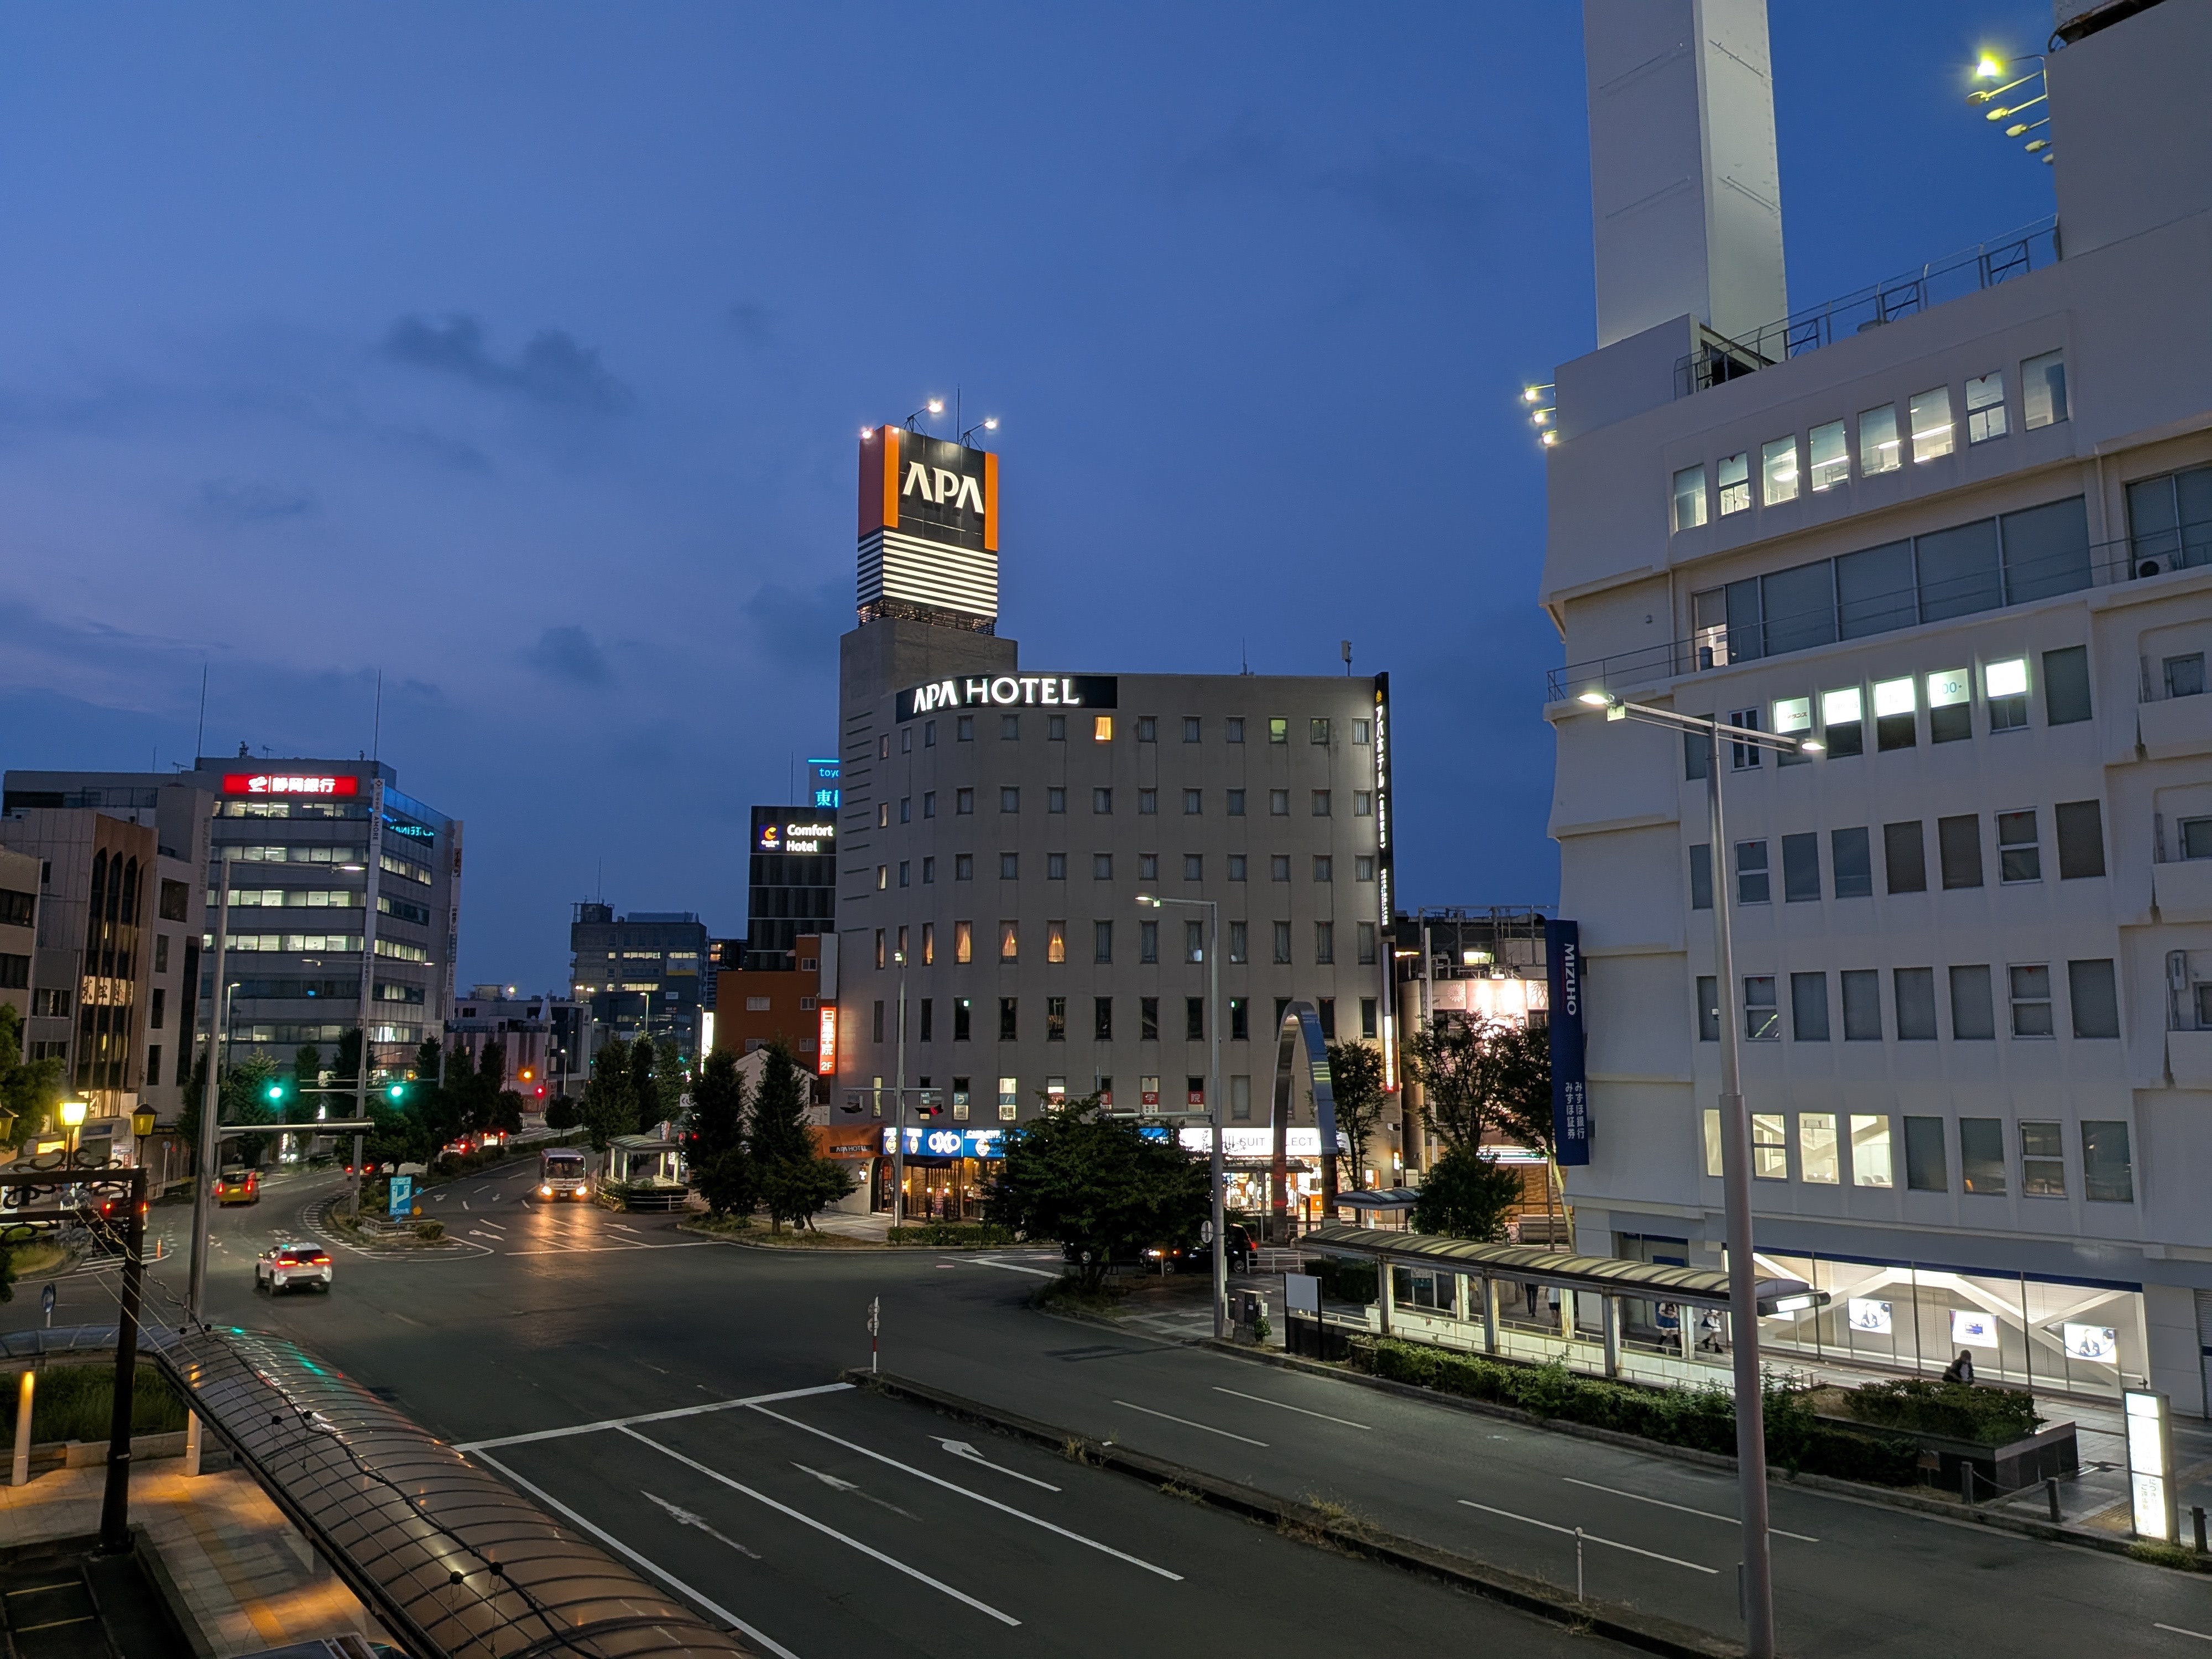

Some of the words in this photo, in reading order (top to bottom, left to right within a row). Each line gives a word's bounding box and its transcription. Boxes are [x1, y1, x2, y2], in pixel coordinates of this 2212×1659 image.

[901, 461, 985, 515] APA
[913, 679, 958, 713] APA
[966, 677, 1080, 705] HOTEL
[272, 777, 336, 792] 静岡銀行
[787, 824, 833, 837] Comfort
[786, 840, 818, 852] Hotel
[1564, 943, 1577, 1016] MIZUHO
[821, 1061, 833, 1071] 2F
[1565, 1081, 1575, 1139] みずほ証券
[1575, 1081, 1585, 1139] みずほ銀行
[1240, 1137, 1265, 1146] SUIT
